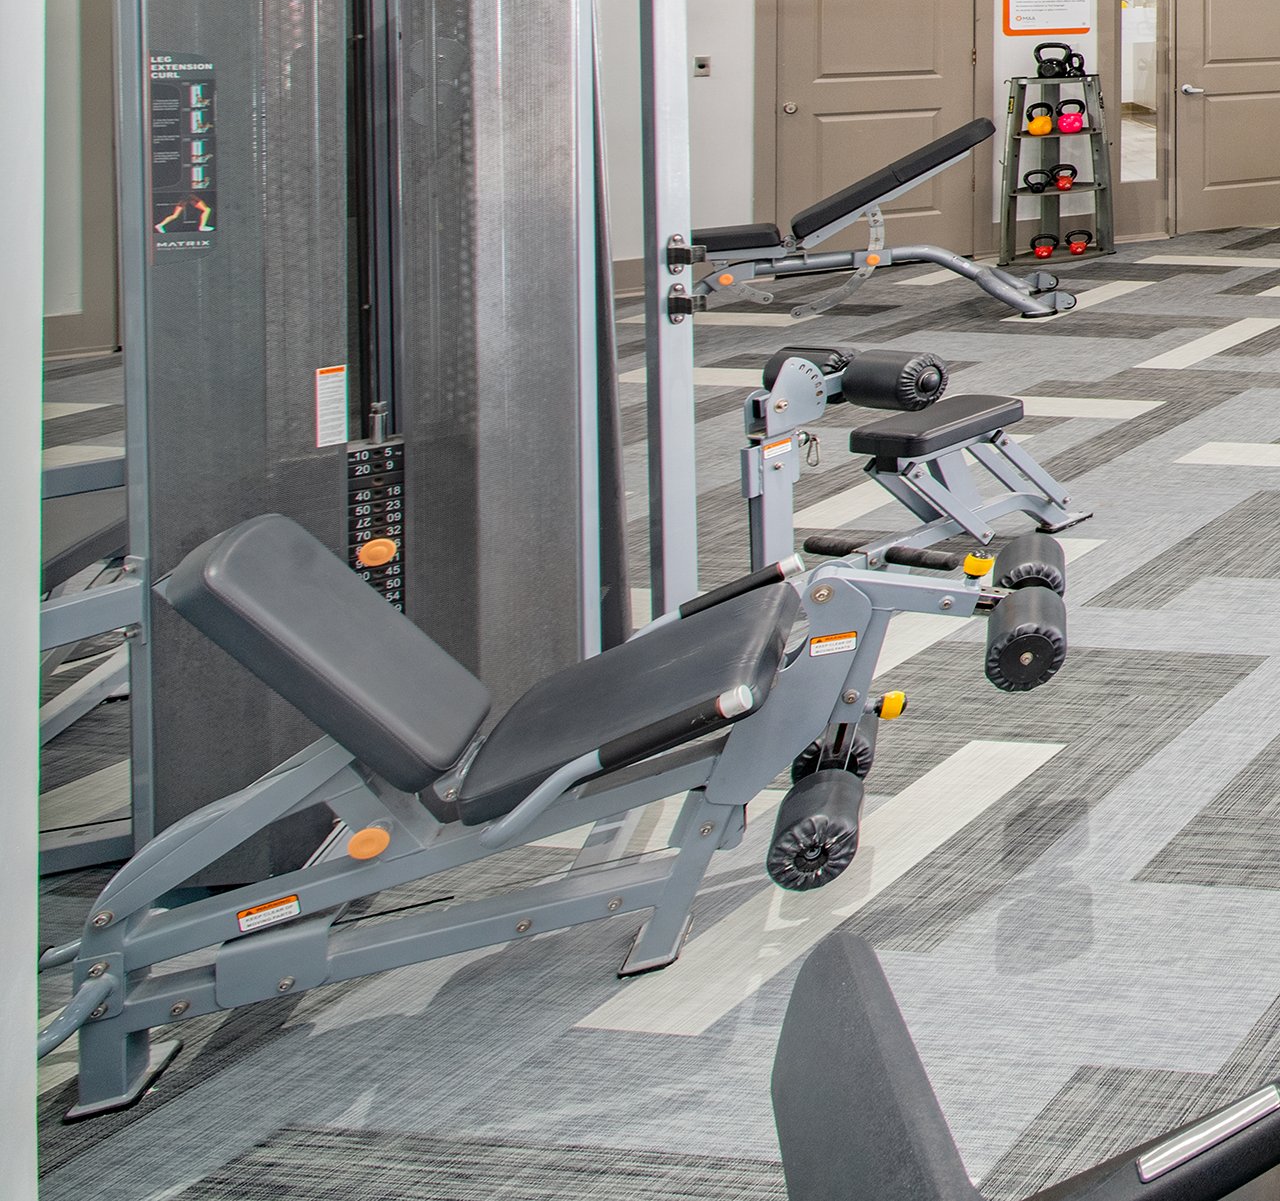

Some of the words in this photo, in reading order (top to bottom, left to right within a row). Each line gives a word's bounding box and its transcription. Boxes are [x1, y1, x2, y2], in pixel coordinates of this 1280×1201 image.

[151, 63, 213, 71] EXTENSION
[354, 451, 369, 460] 10
[384, 448, 392, 457] 5
[355, 464, 371, 475] 20
[386, 461, 394, 470] 9
[355, 491, 371, 500] 40
[387, 486, 401, 496] 18
[355, 505, 371, 516] 50
[386, 500, 401, 511] 23
[356, 531, 371, 541] 70
[386, 525, 401, 536] 32
[385, 565, 401, 575] 45
[386, 578, 401, 589] 50
[386, 591, 400, 602] 54
